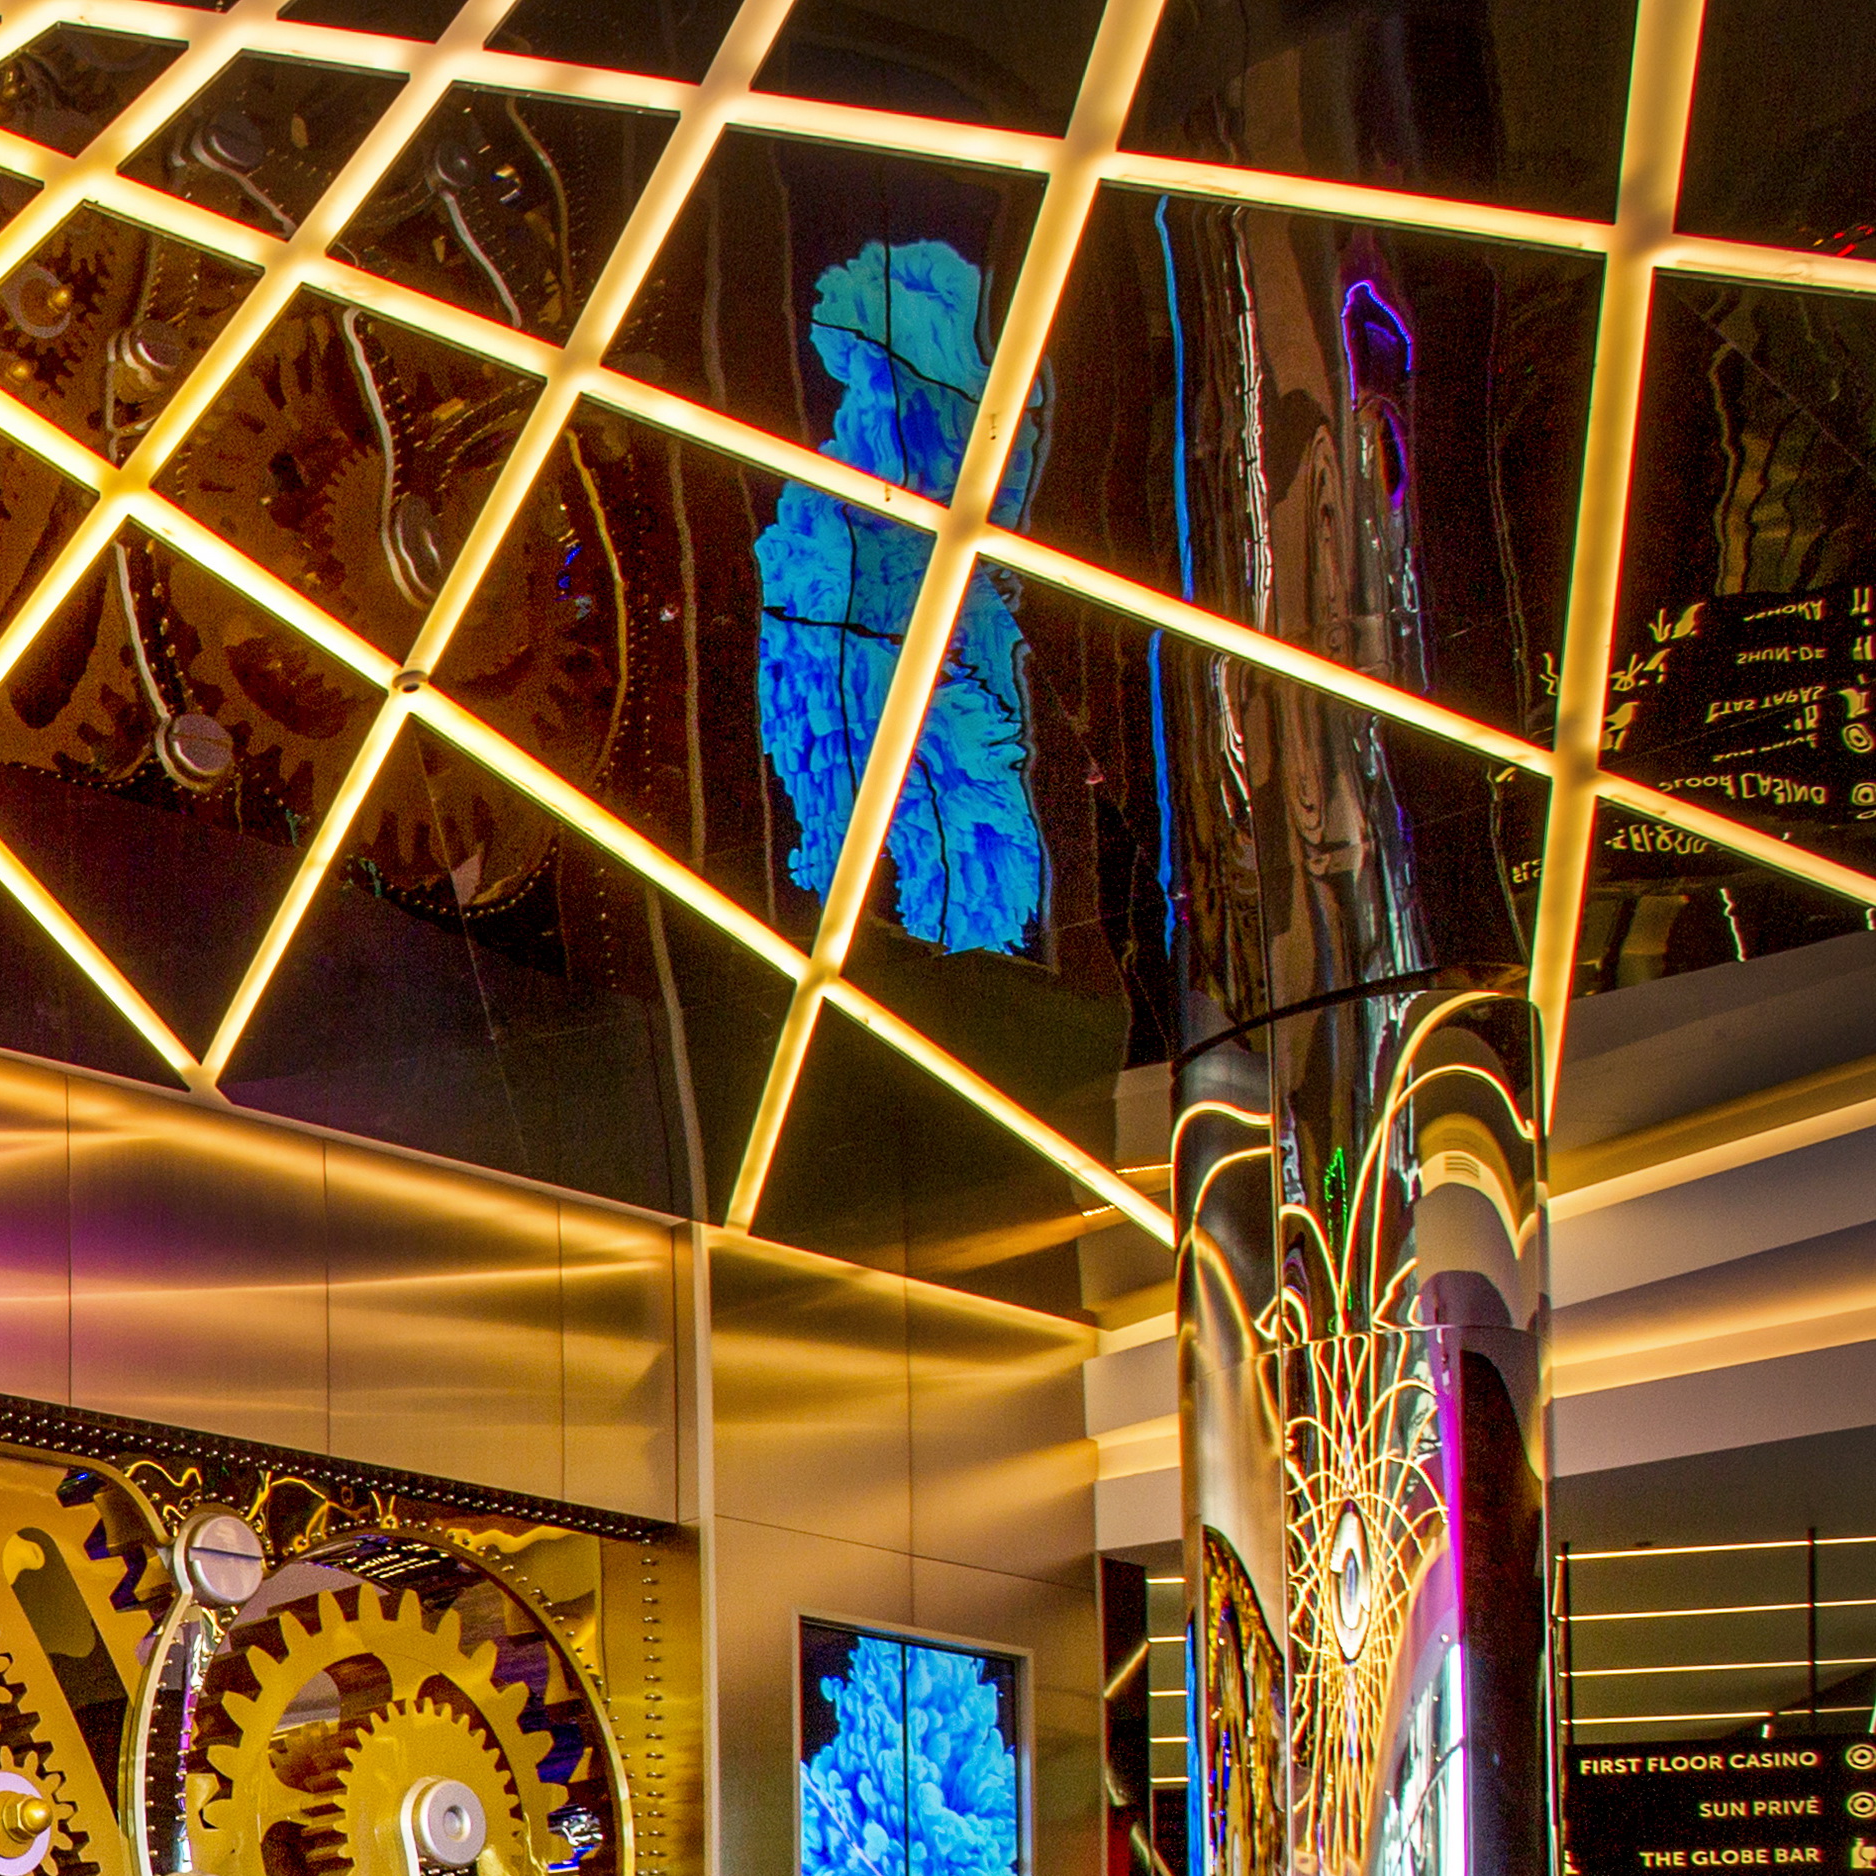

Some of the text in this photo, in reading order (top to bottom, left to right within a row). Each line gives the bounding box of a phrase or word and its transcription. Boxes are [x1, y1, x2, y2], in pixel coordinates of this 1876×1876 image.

[1579, 1751, 1819, 1775] FIRST FLOOR CASINO
[1698, 1795, 1822, 1818] SUN PRIVÉ
[1639, 1847, 1821, 1867] THE GLOBE BAR
